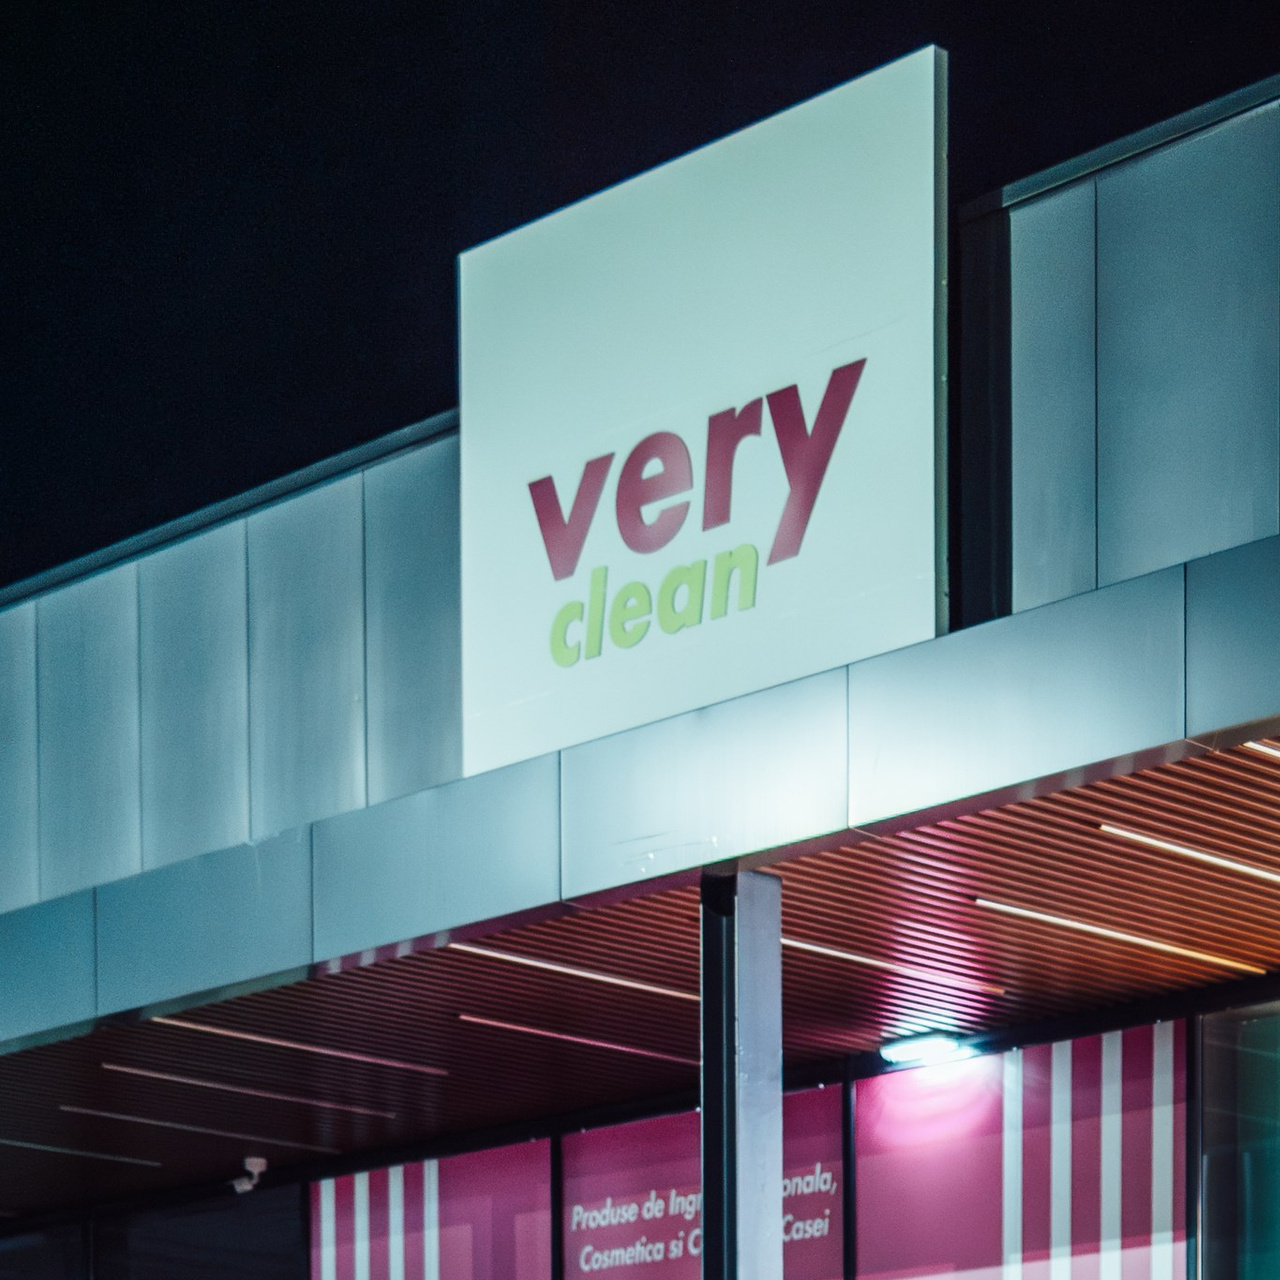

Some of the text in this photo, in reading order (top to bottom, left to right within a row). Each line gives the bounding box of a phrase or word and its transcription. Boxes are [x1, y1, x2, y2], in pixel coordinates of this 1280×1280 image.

[528, 357, 867, 581] very
[550, 543, 760, 668] clean
[571, 1197, 637, 1232] Produse
[642, 1190, 665, 1221] de
[579, 1236, 665, 1272] Cosmetica
[668, 1230, 685, 1260] si
[783, 1208, 831, 1243] Casei
